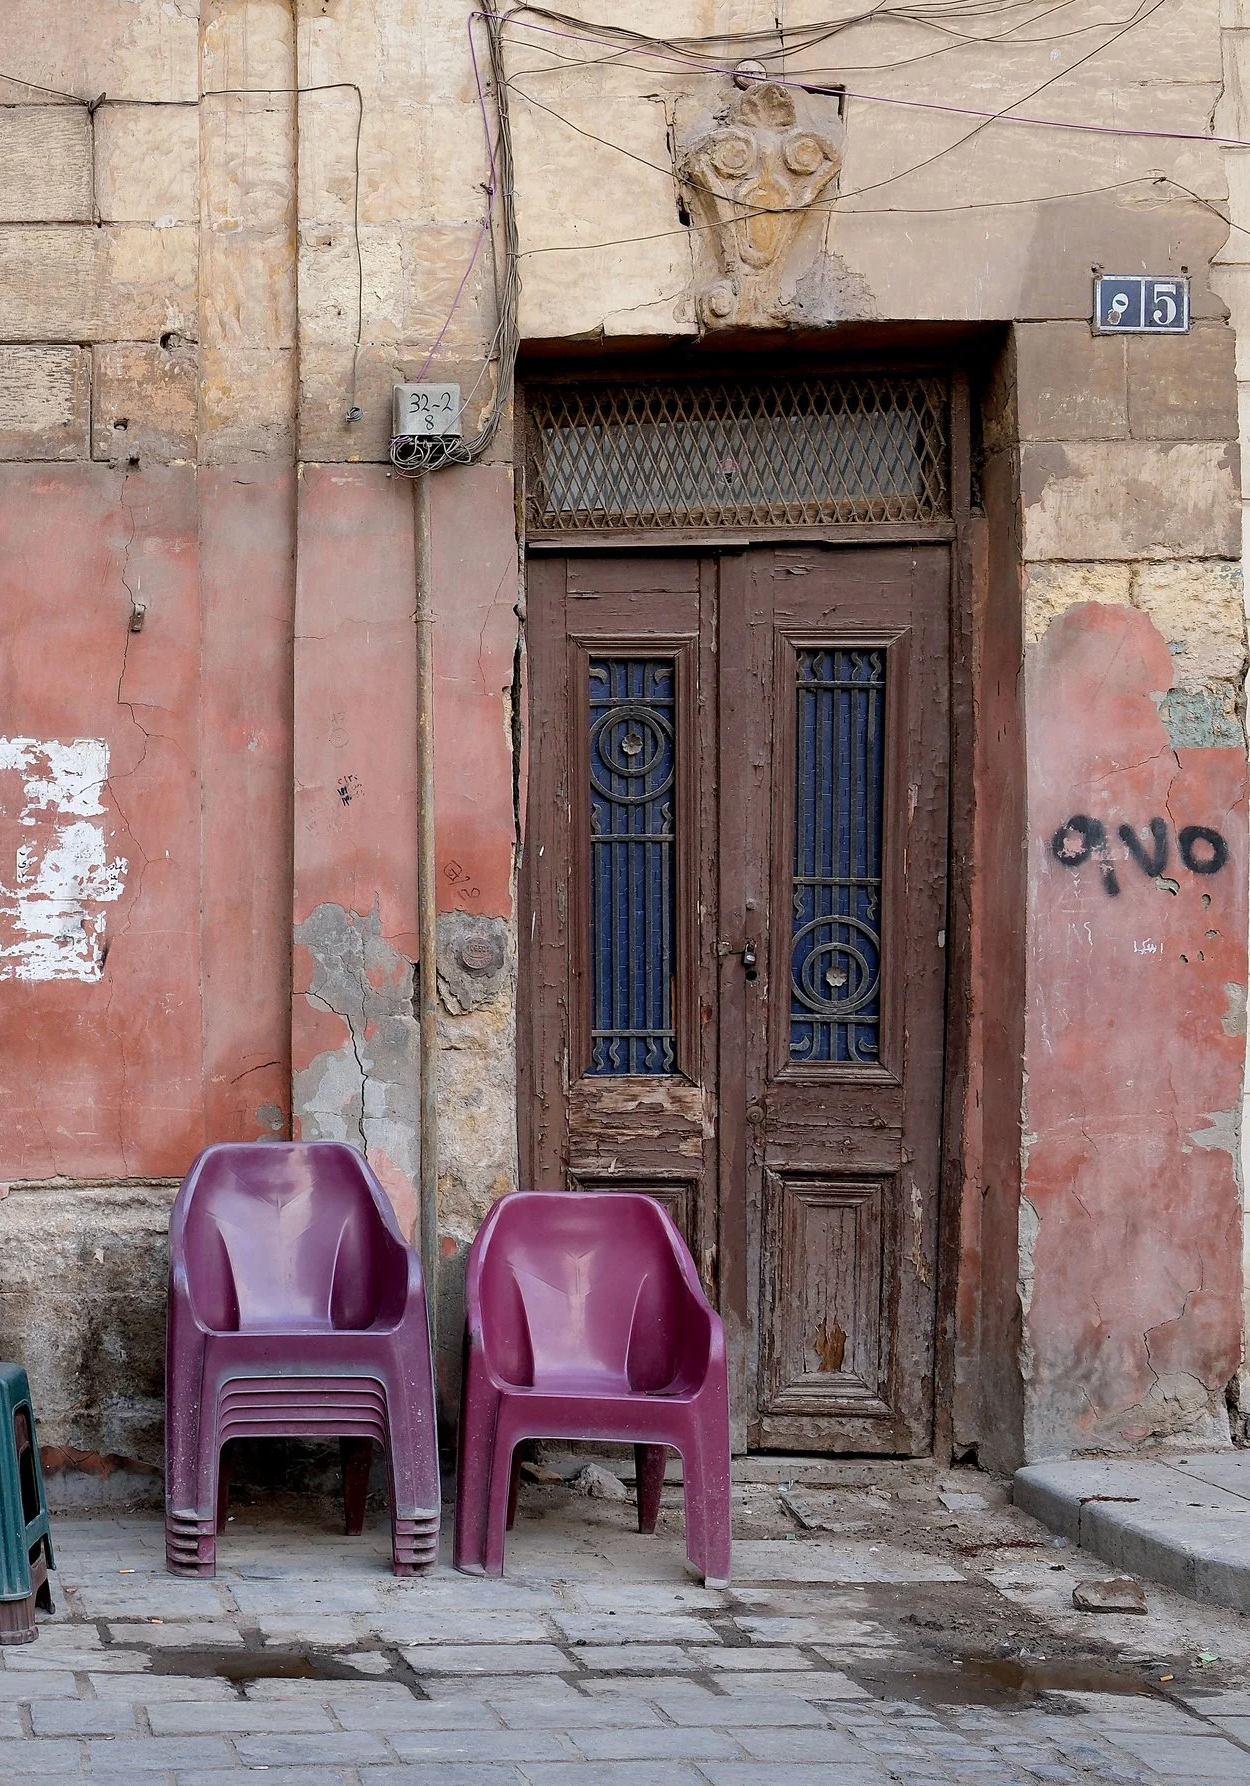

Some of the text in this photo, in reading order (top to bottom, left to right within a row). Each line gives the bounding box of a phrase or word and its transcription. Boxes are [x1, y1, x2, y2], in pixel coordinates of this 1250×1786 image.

[1153, 283, 1177, 325] 5
[408, 391, 453, 414] 32-2
[424, 414, 435, 431] 8
